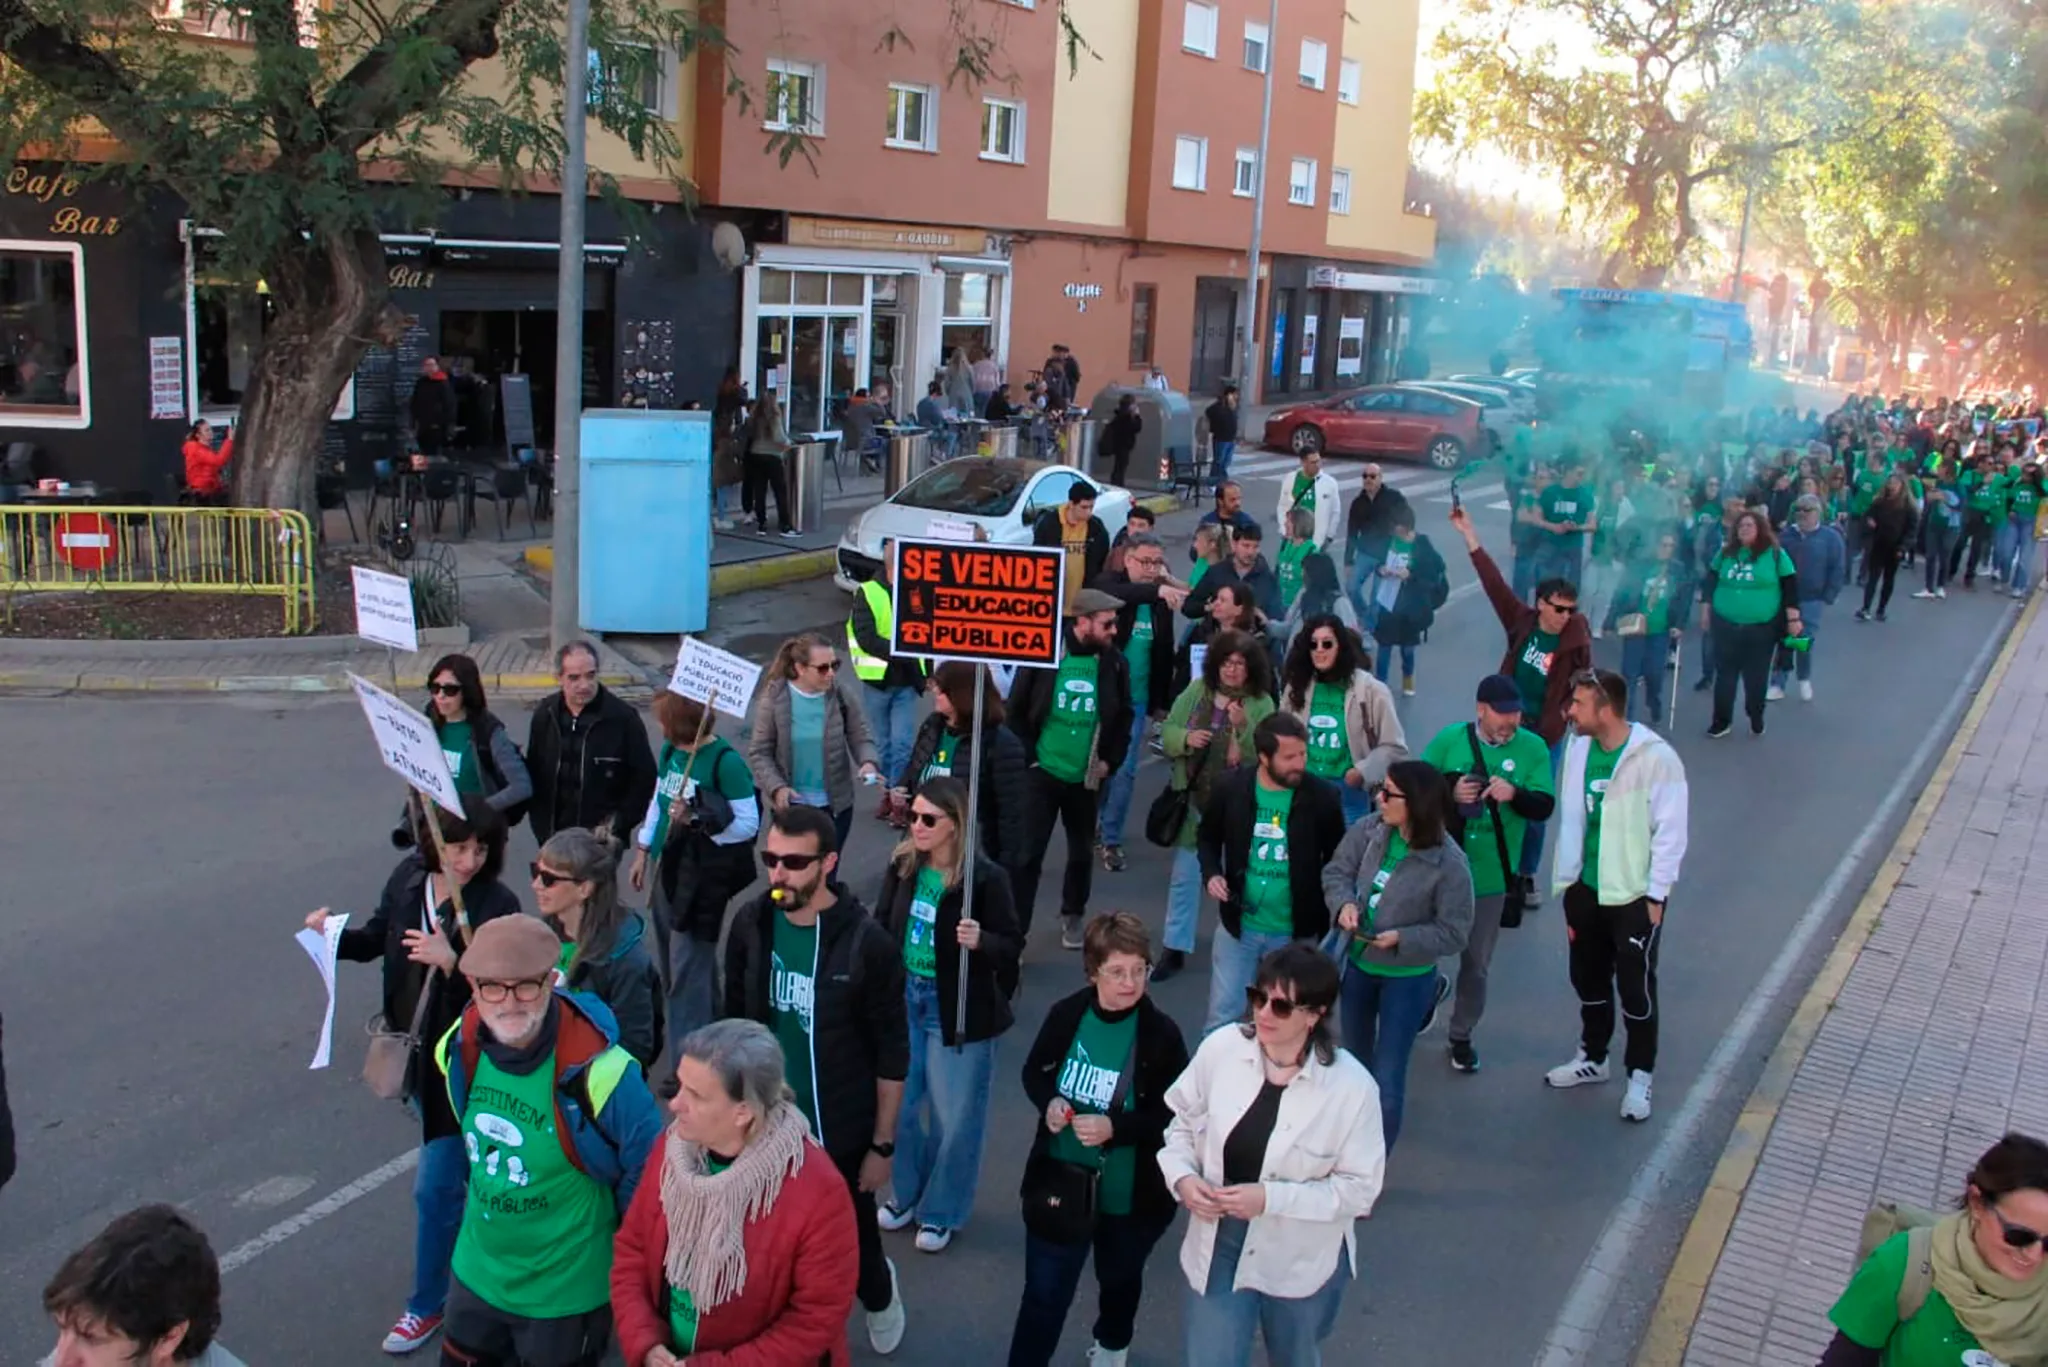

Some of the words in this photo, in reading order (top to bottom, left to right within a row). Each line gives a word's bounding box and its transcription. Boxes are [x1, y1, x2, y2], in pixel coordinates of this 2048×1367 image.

[49, 207, 119, 234] Bar
[388, 264, 435, 288] Bar
[903, 548, 942, 582] SE
[951, 552, 1055, 590] VENDE
[935, 592, 1051, 619] EDUCACIÓ
[935, 623, 1047, 651] PÚBLICA
[1060, 1058, 1079, 1090] LA
